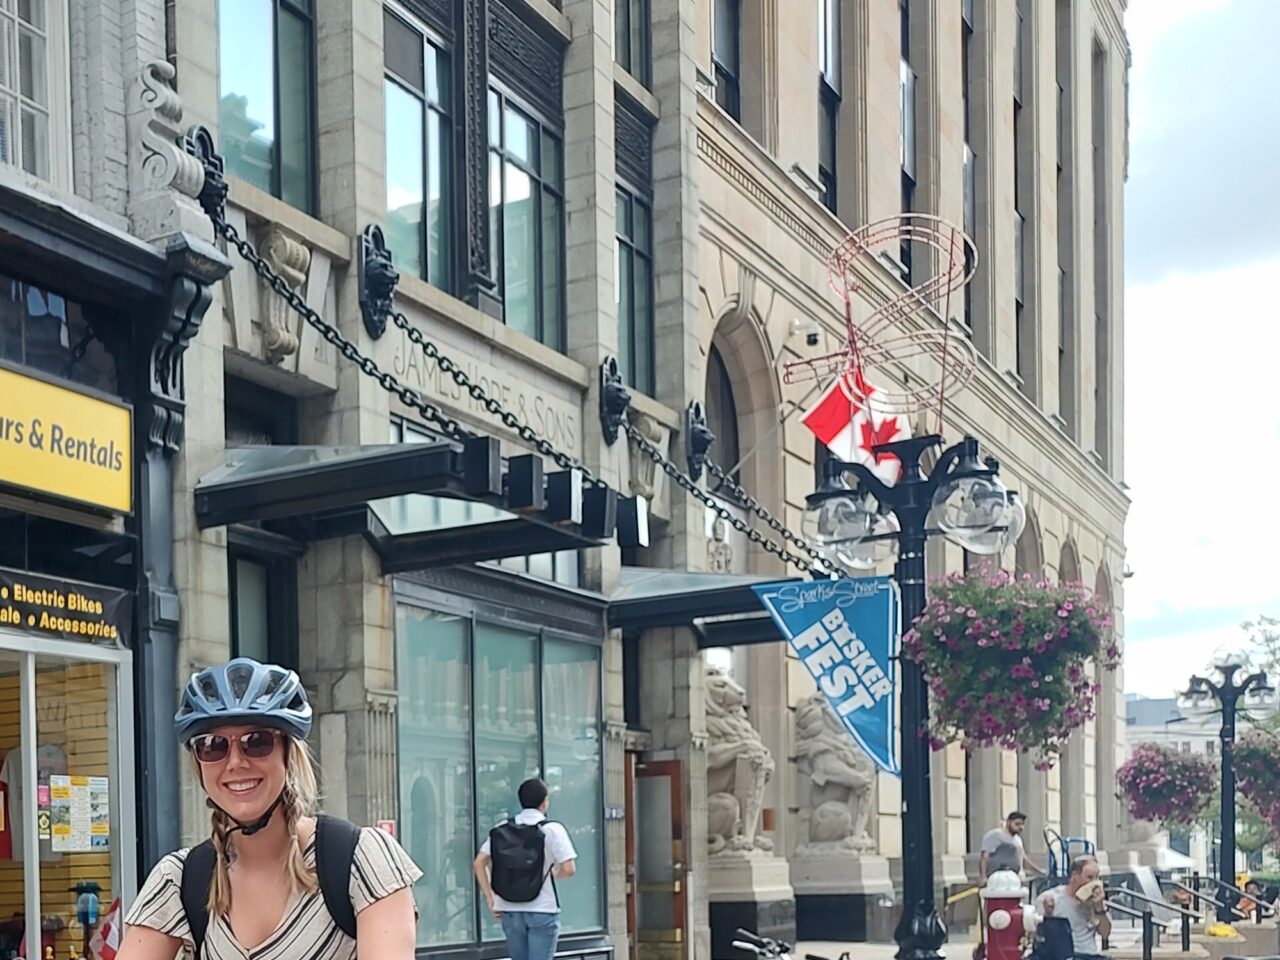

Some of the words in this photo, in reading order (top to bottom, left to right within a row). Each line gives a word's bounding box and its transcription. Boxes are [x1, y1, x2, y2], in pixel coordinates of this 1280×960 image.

[28, 420, 44, 450] &
[51, 424, 122, 472] Rentals
[14, 584, 65, 609] Electric
[67, 593, 103, 615] Bikes
[39, 611, 117, 639] Accessories
[791, 621, 875, 718] FEST
